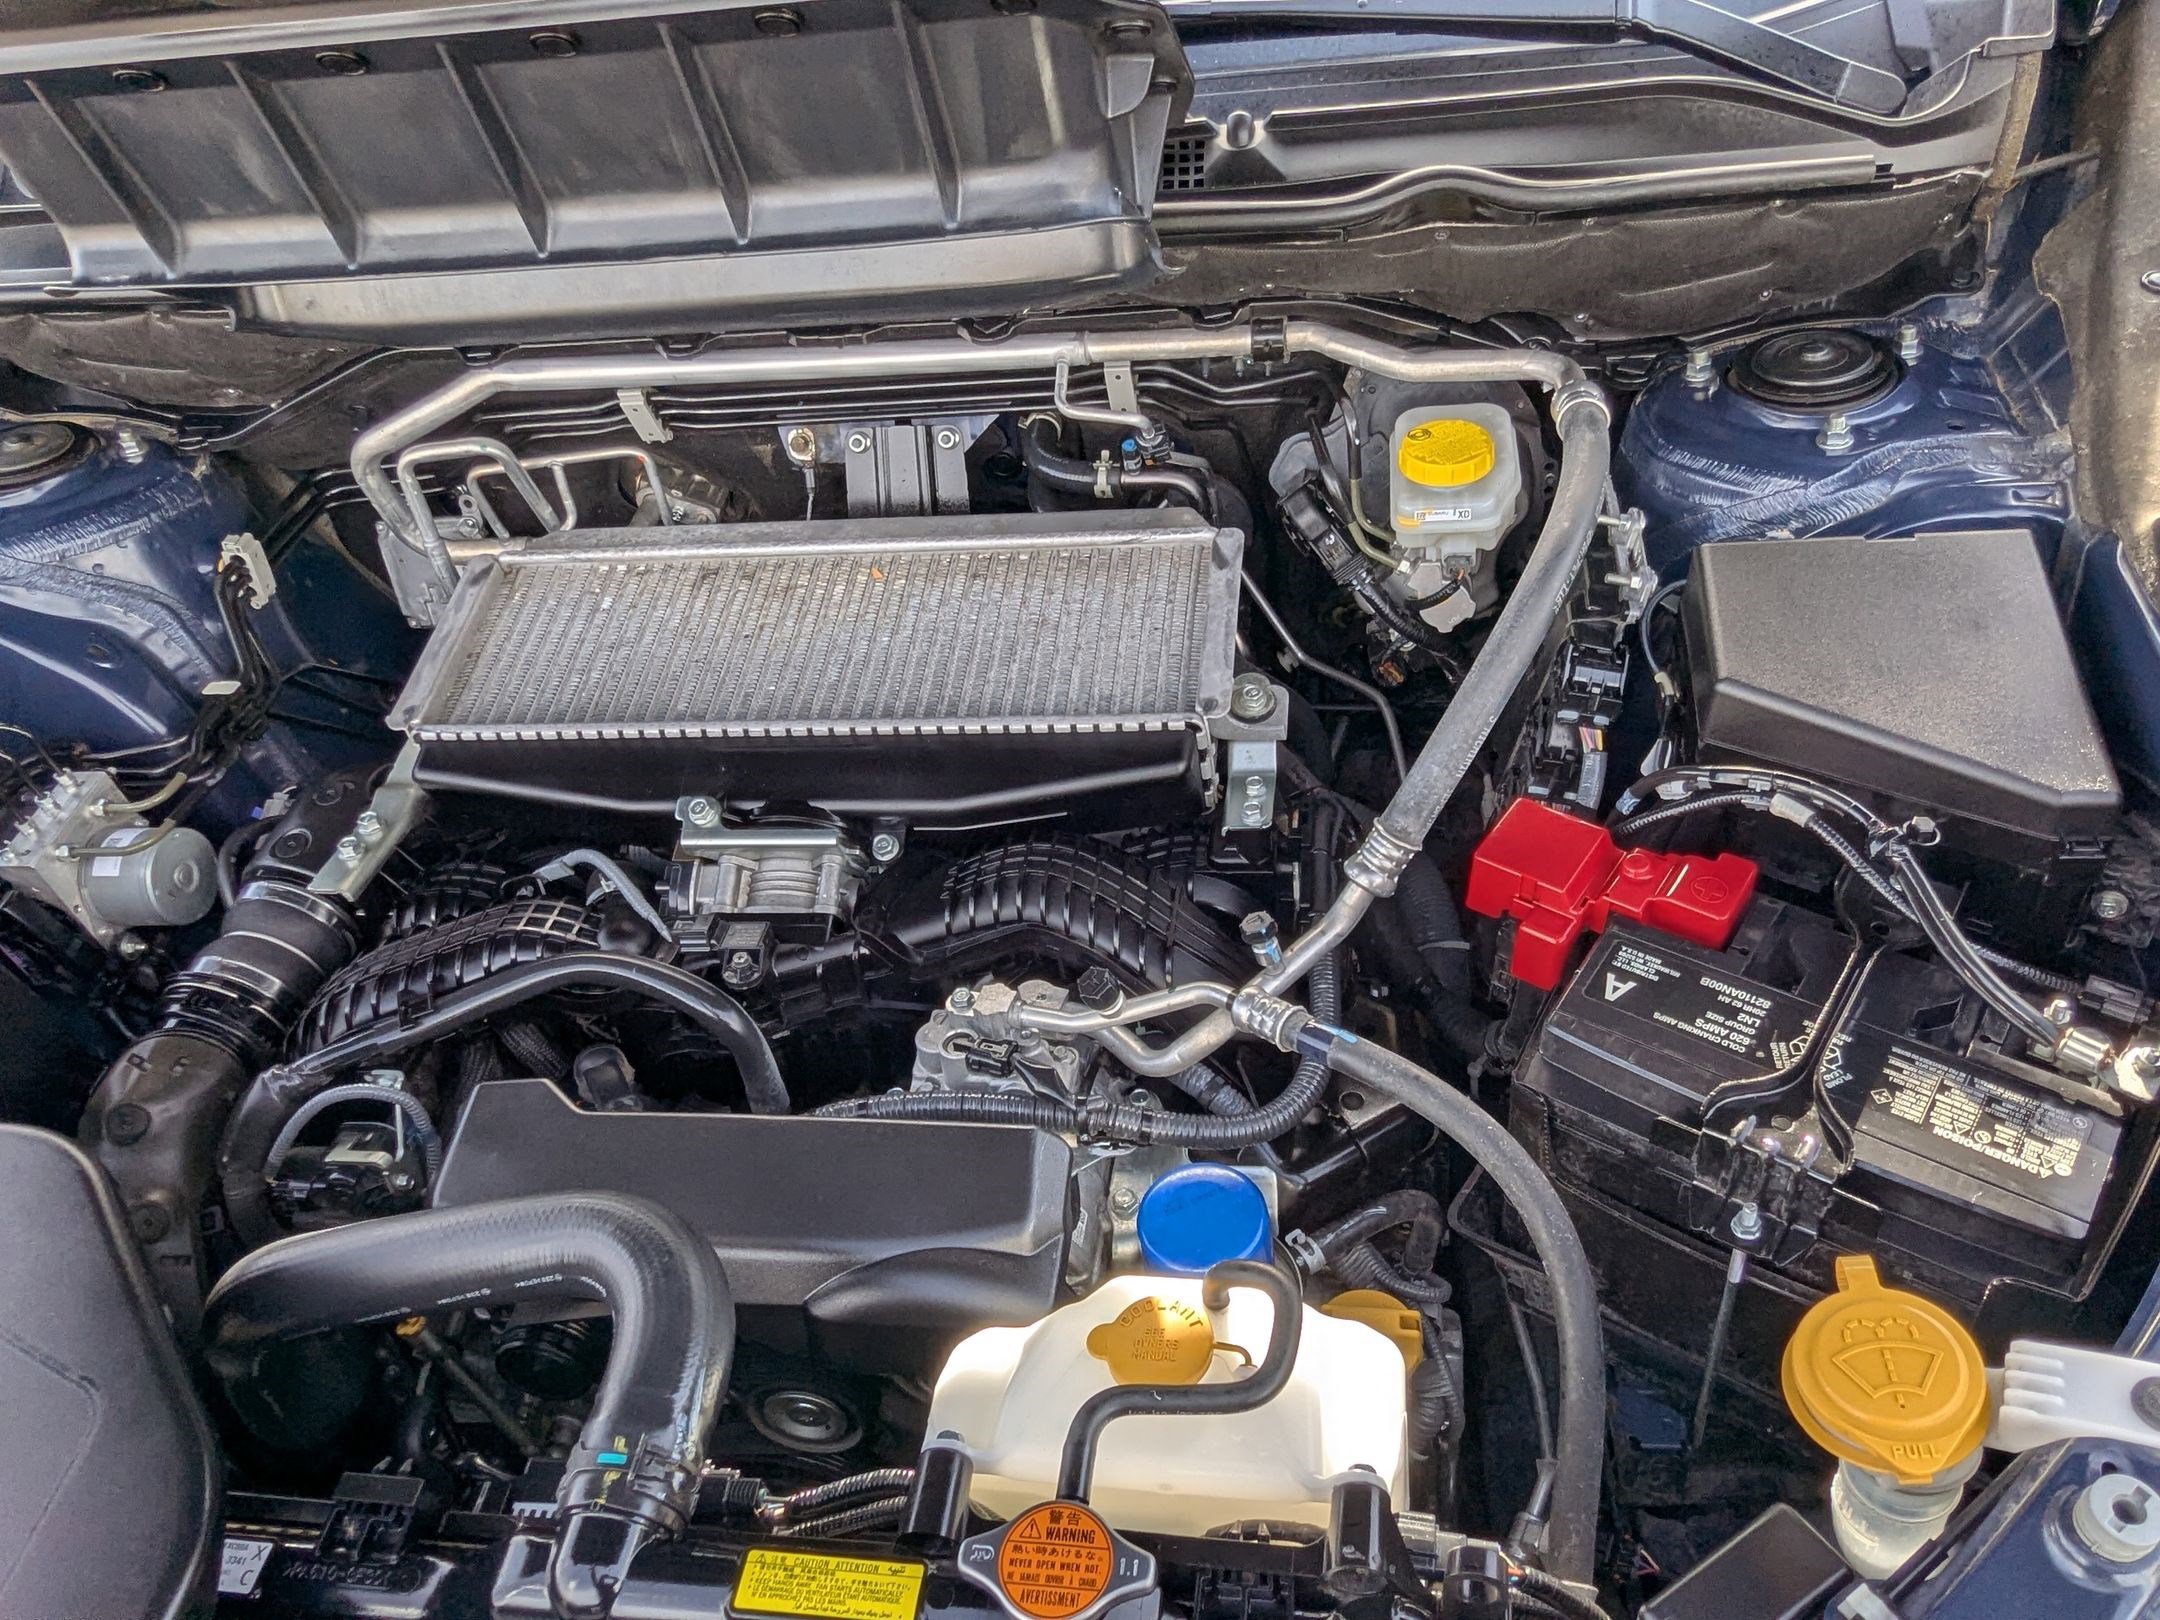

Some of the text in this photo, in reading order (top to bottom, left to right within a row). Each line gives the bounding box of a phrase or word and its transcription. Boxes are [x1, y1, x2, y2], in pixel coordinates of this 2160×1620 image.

[1645, 955, 1661, 964] MADE
[1700, 977, 1772, 1009] 82110AN00B
[1717, 994, 1766, 1017] 20HR 62 AH
[1705, 1011, 1756, 1035] GROUP SIZE
[1737, 1013, 1761, 1027] LN2
[1653, 1012, 1746, 1053] COLD CRANKING AMPS
[1695, 1018, 1751, 1045] 620 AMPS
[1823, 1069, 1843, 1081] LEAD
[1933, 1126, 2039, 1174] DANGER/POISON
[1132, 1349, 1177, 1362] MANUAL
[1891, 1443, 1942, 1460] PULL
[1049, 1509, 1082, 1526] 警告
[1045, 1526, 1096, 1545] WARNING
[794, 1557, 829, 1569] CAUTION
[834, 1561, 880, 1573] ATTENTION
[1009, 1558, 1033, 1569] NEVER
[1036, 1560, 1056, 1570] OPEN
[1059, 1562, 1080, 1573] WHEN
[1119, 1557, 1139, 1577] 1.1
[1019, 1588, 1081, 1608] AVERTISSMENT
